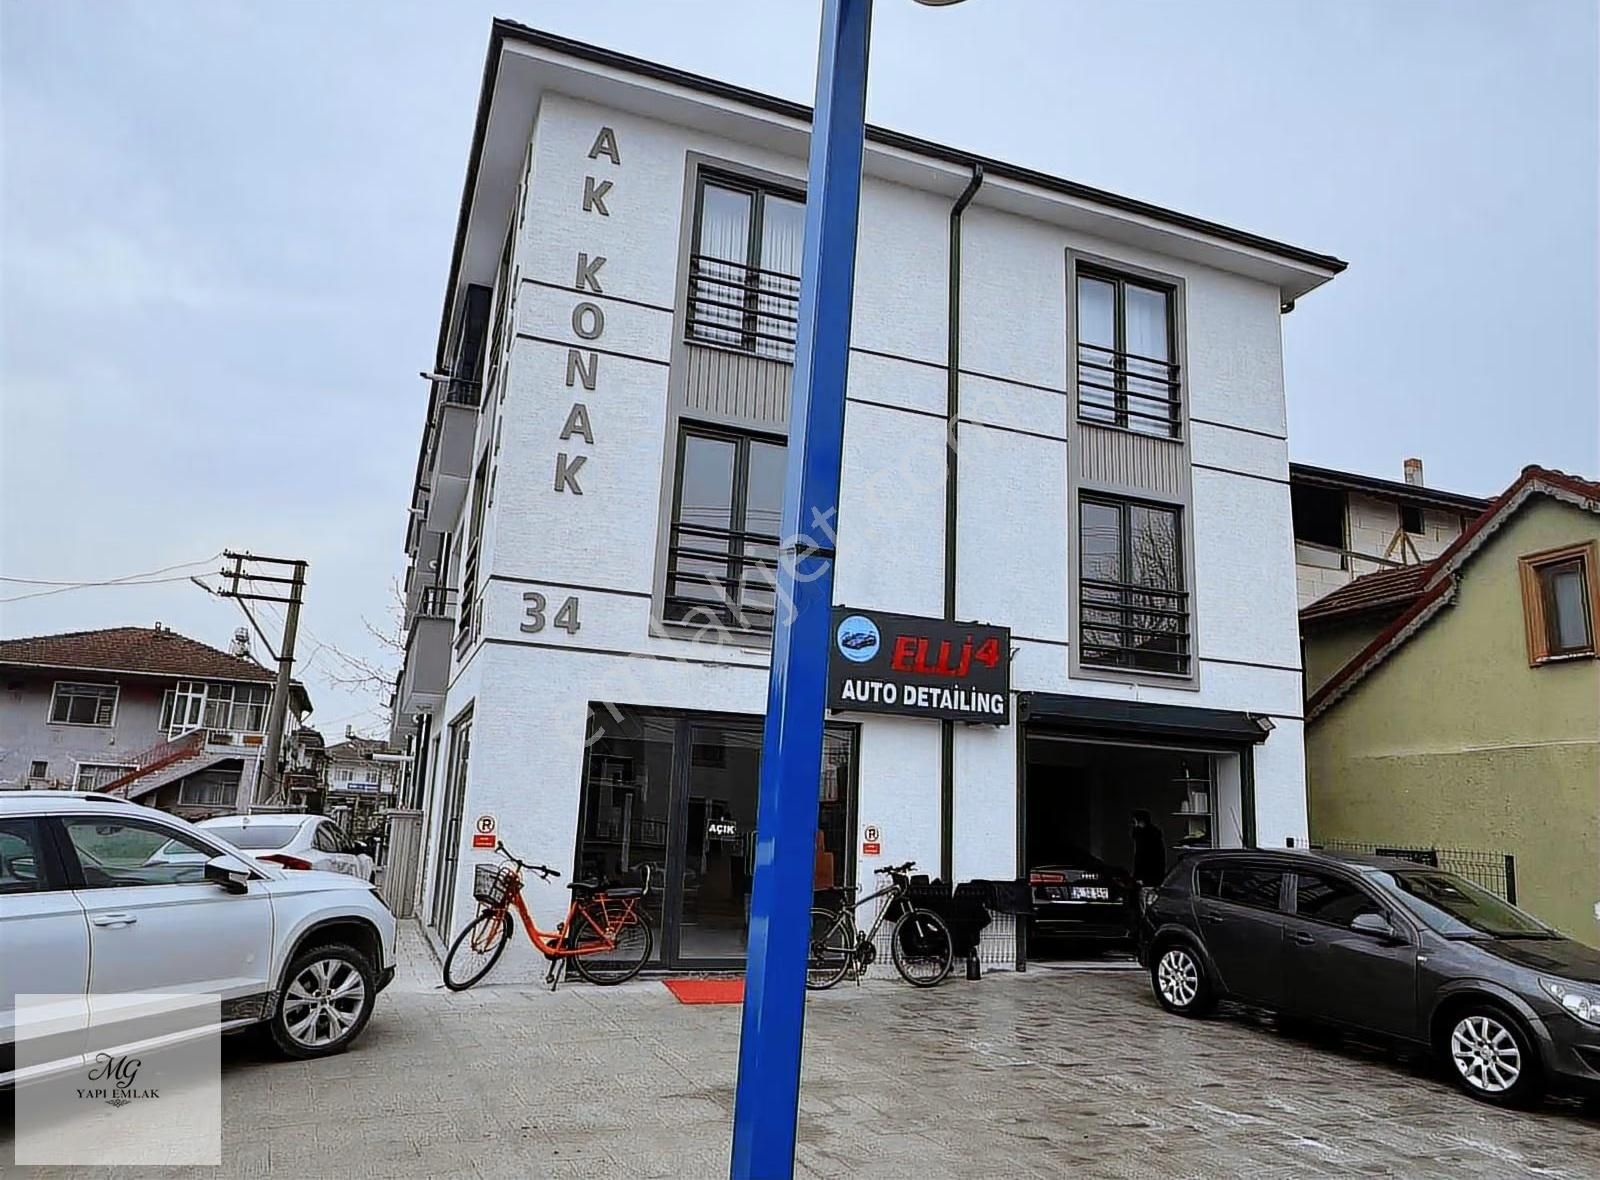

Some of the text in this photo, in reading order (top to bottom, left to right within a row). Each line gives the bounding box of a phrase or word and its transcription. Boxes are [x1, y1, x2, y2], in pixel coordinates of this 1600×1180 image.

[520, 592, 581, 635] 34
[842, 679, 898, 704] AUTO
[708, 824, 736, 835] AÇIK
